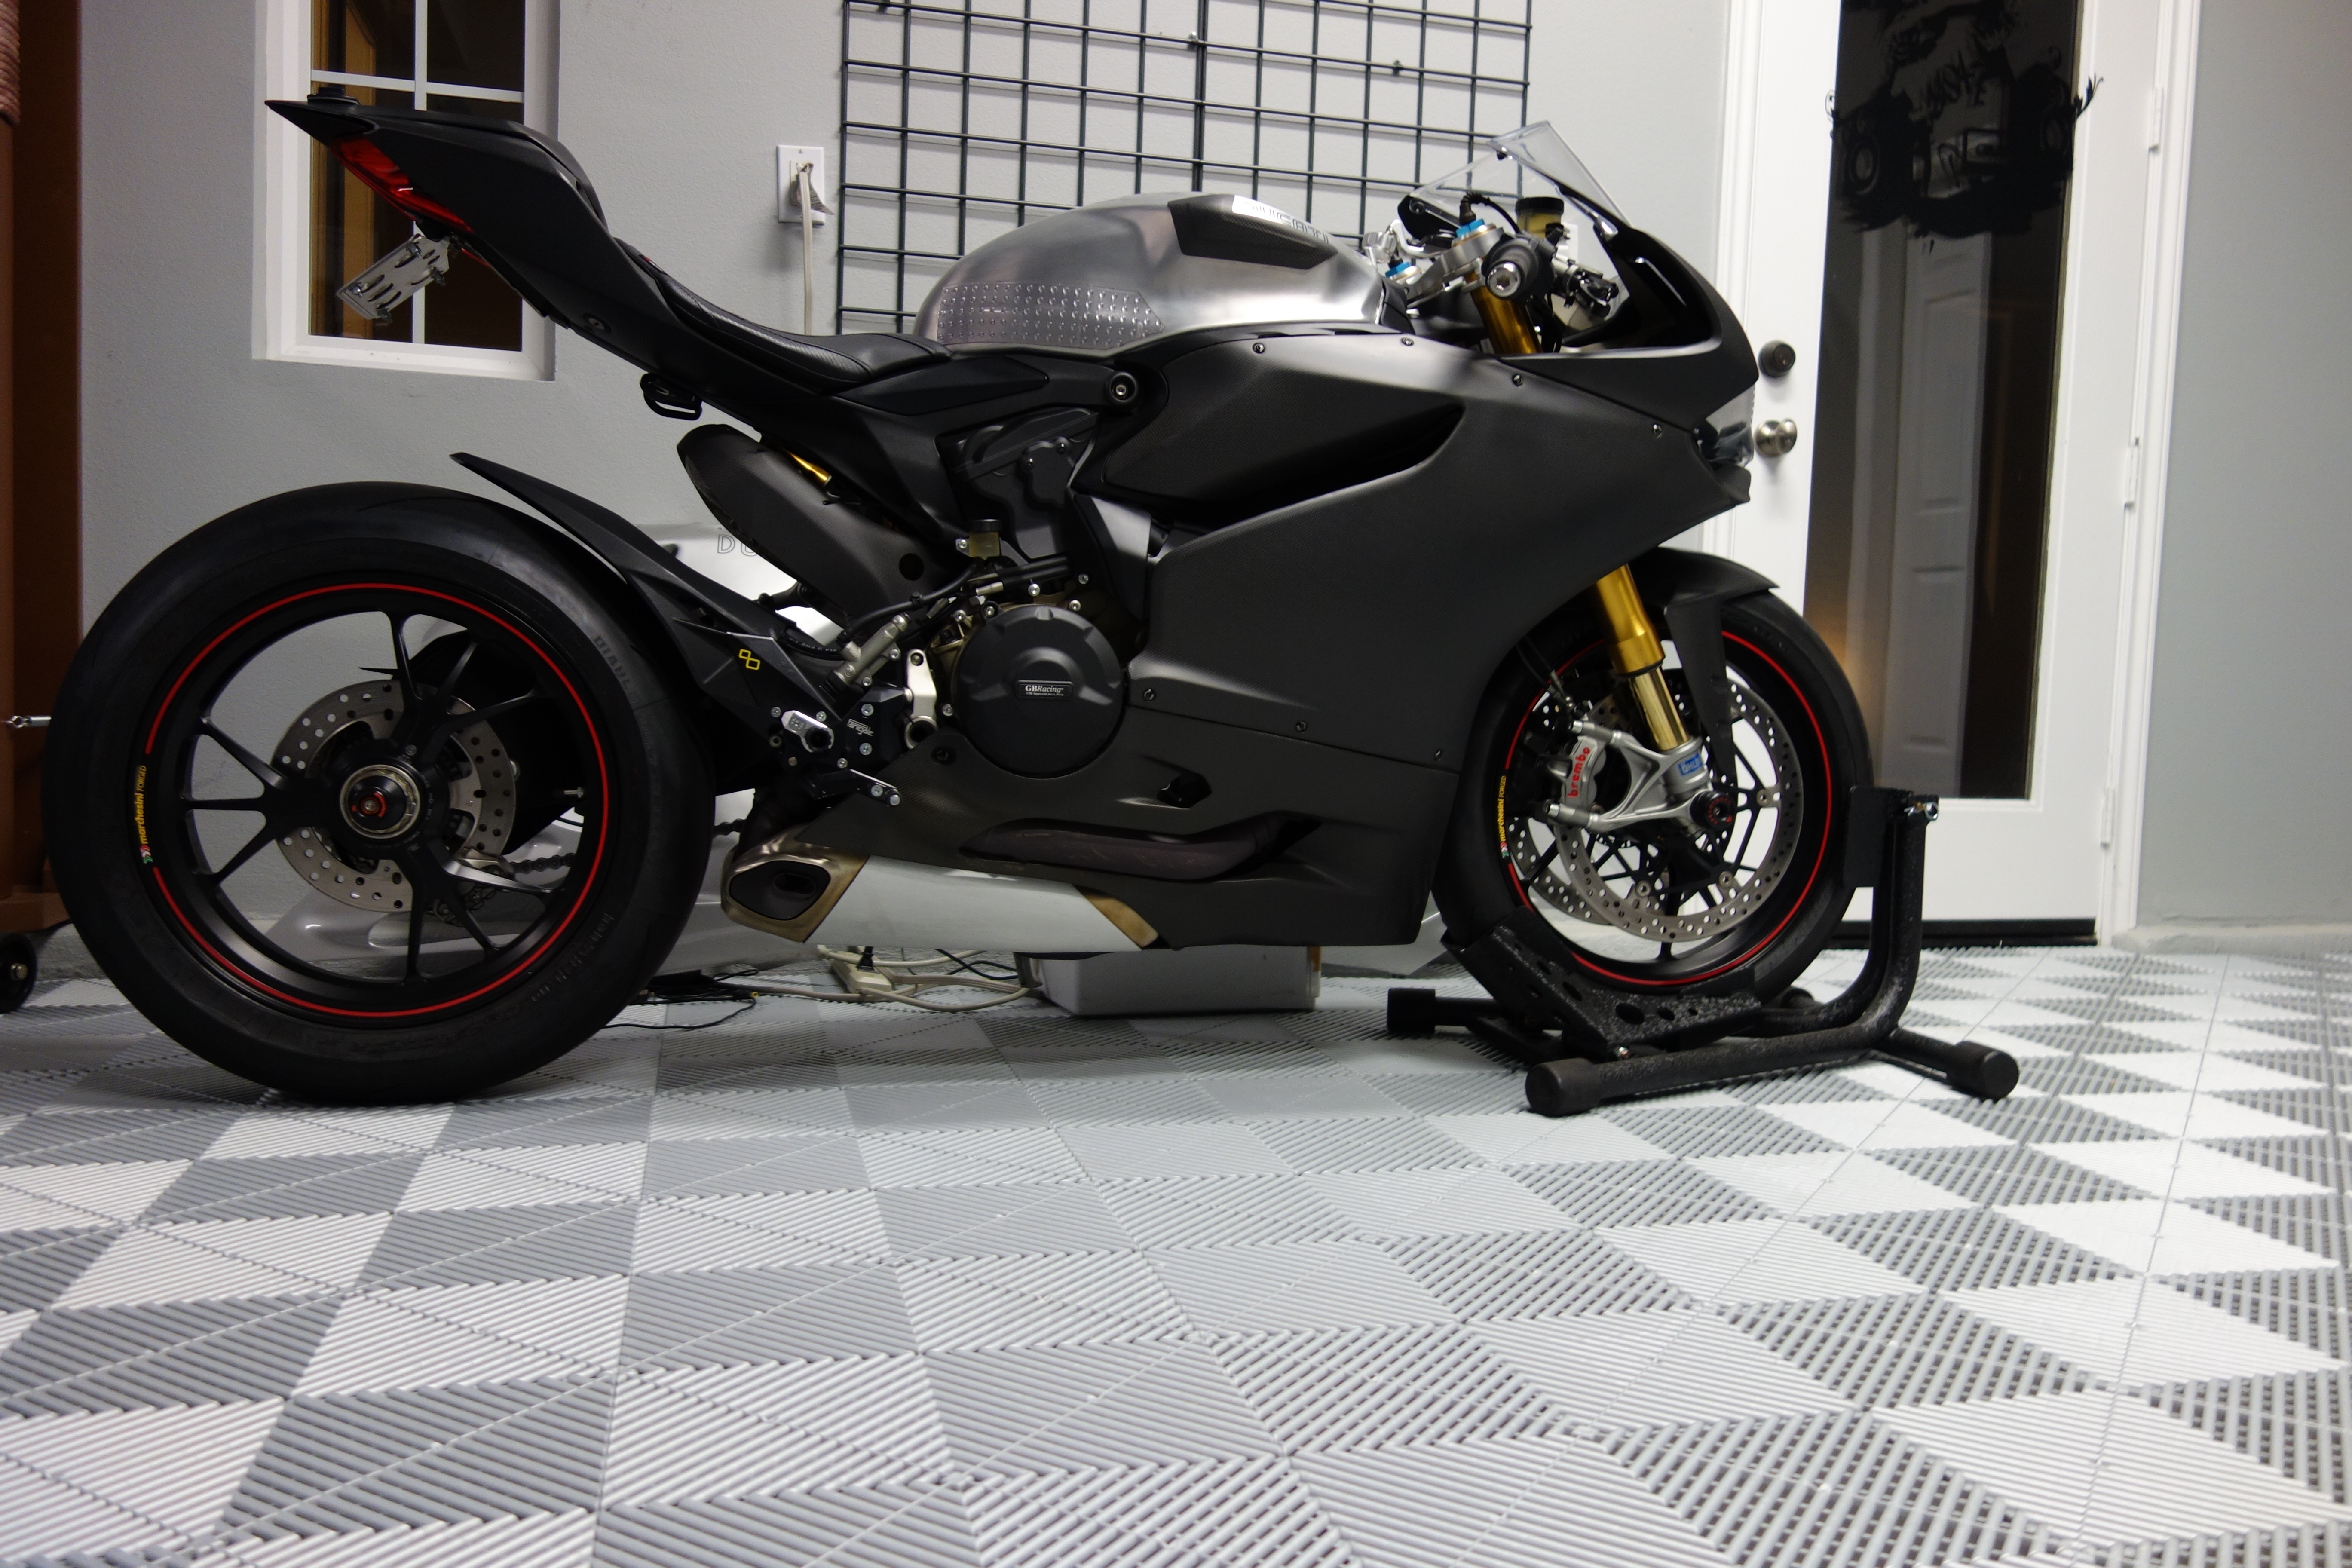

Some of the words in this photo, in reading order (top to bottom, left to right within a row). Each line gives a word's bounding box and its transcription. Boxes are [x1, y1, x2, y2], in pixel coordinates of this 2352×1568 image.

[1025, 685, 1063, 693] GBRacing
[1567, 748, 1590, 797] brembo
[134, 792, 148, 844] marchesini
